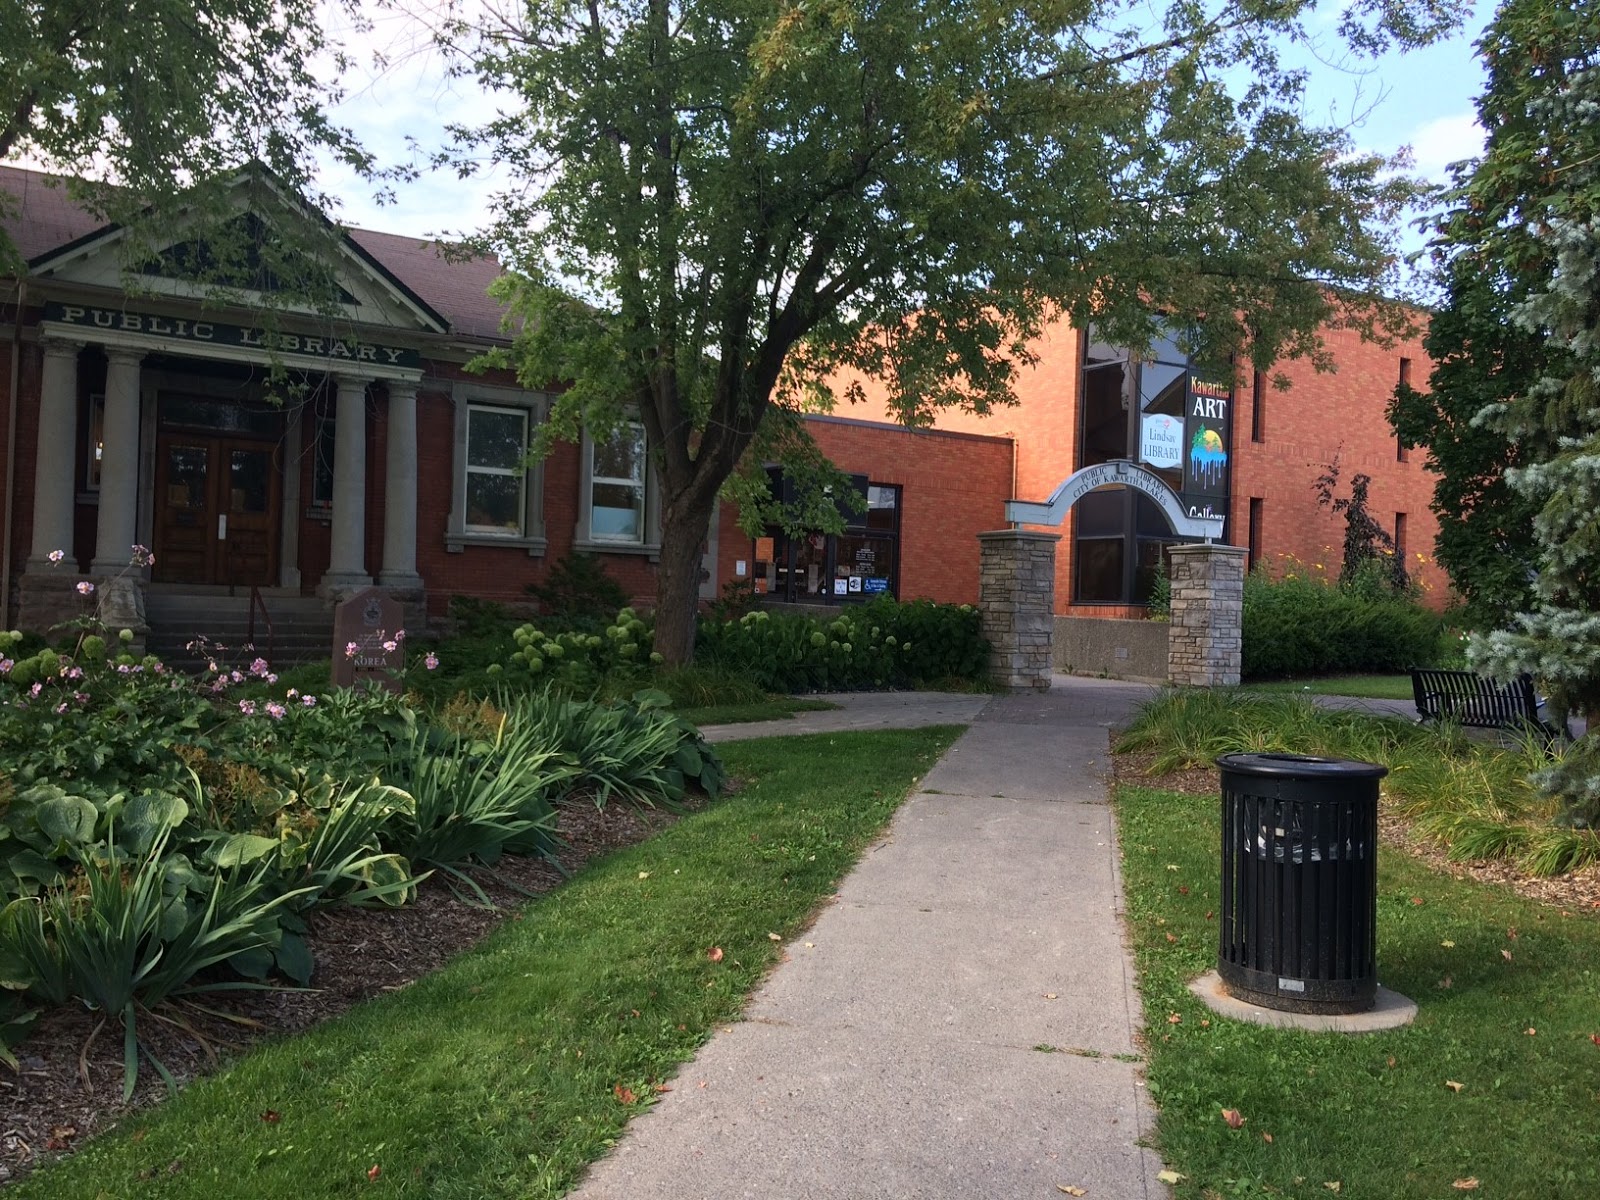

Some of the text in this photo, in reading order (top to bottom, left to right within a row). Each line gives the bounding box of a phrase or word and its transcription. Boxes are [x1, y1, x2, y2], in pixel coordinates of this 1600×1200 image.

[61, 306, 404, 363] PUBLIC LBRARY
[1192, 396, 1227, 419] ART
[1149, 428, 1176, 444] Lindsay
[1144, 444, 1180, 460] LIBRARY
[1073, 474, 1168, 506] CITY OF KAWARTHA LAKES
[1080, 467, 1167, 493] PUBLIC LIBRARY
[354, 657, 387, 666] KOREA
